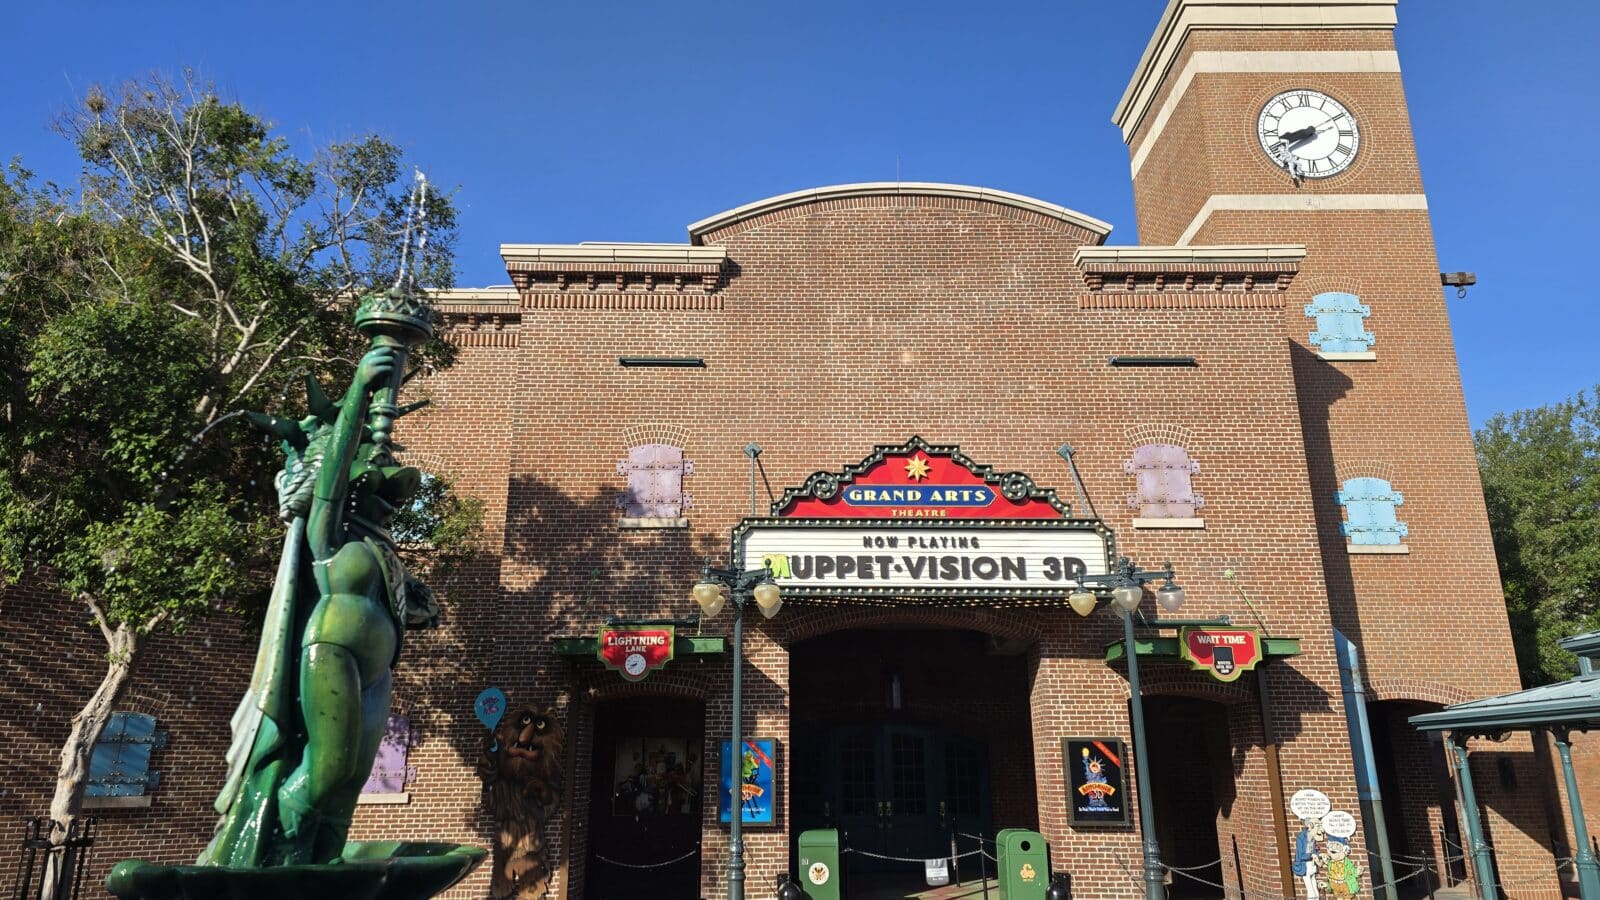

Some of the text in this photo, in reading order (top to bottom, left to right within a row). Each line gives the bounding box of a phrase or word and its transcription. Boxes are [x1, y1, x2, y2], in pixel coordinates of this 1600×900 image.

[849, 490, 986, 501] GRAND ARTS
[891, 509, 946, 517] THEATRE
[863, 536, 980, 550] NOW PLAYING
[1042, 556, 1087, 581] 3D
[607, 636, 665, 645] LIGHTNING
[1197, 635, 1246, 645] WAIT TIME
